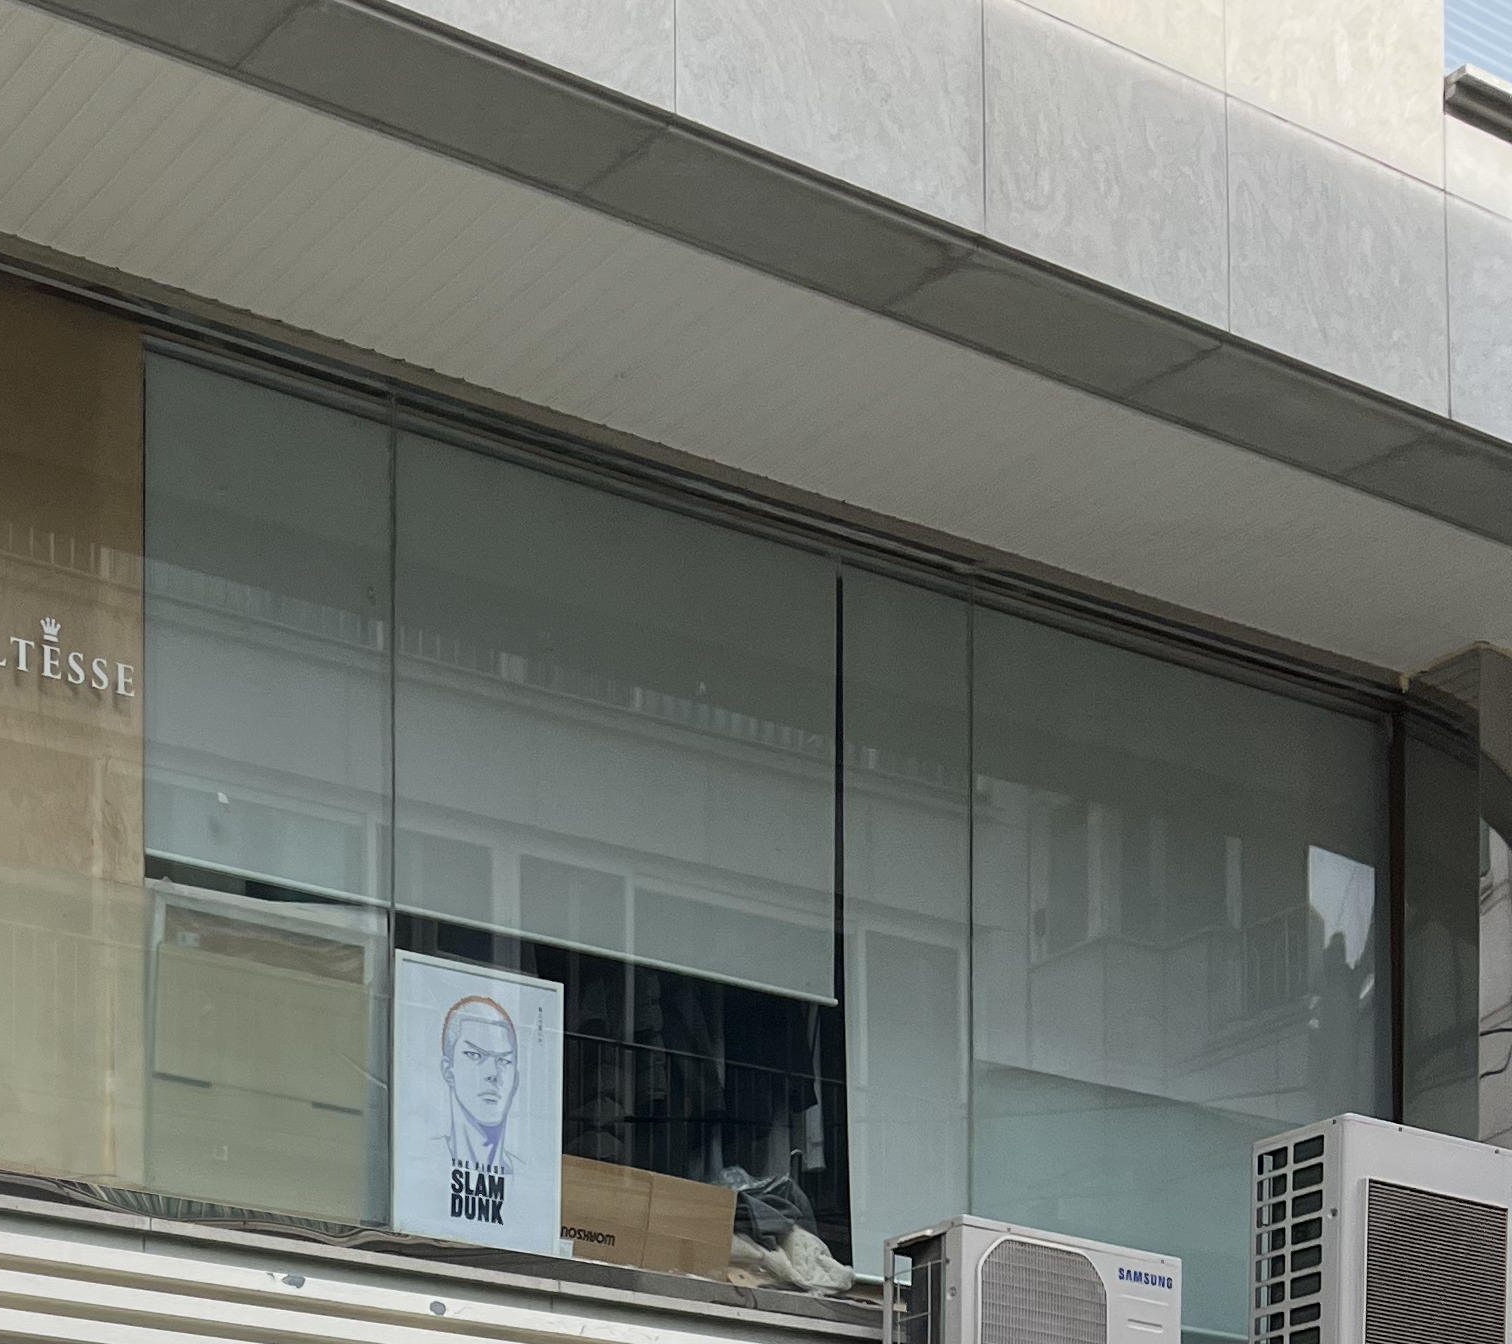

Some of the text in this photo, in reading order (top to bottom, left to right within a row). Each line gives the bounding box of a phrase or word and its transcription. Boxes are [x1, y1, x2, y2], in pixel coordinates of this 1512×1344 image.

[452, 1158, 505, 1174] THE FIRST
[451, 1169, 505, 1200] SLAM
[451, 1193, 504, 1225] DUNK
[1118, 1267, 1173, 1289] SAMSUNG
